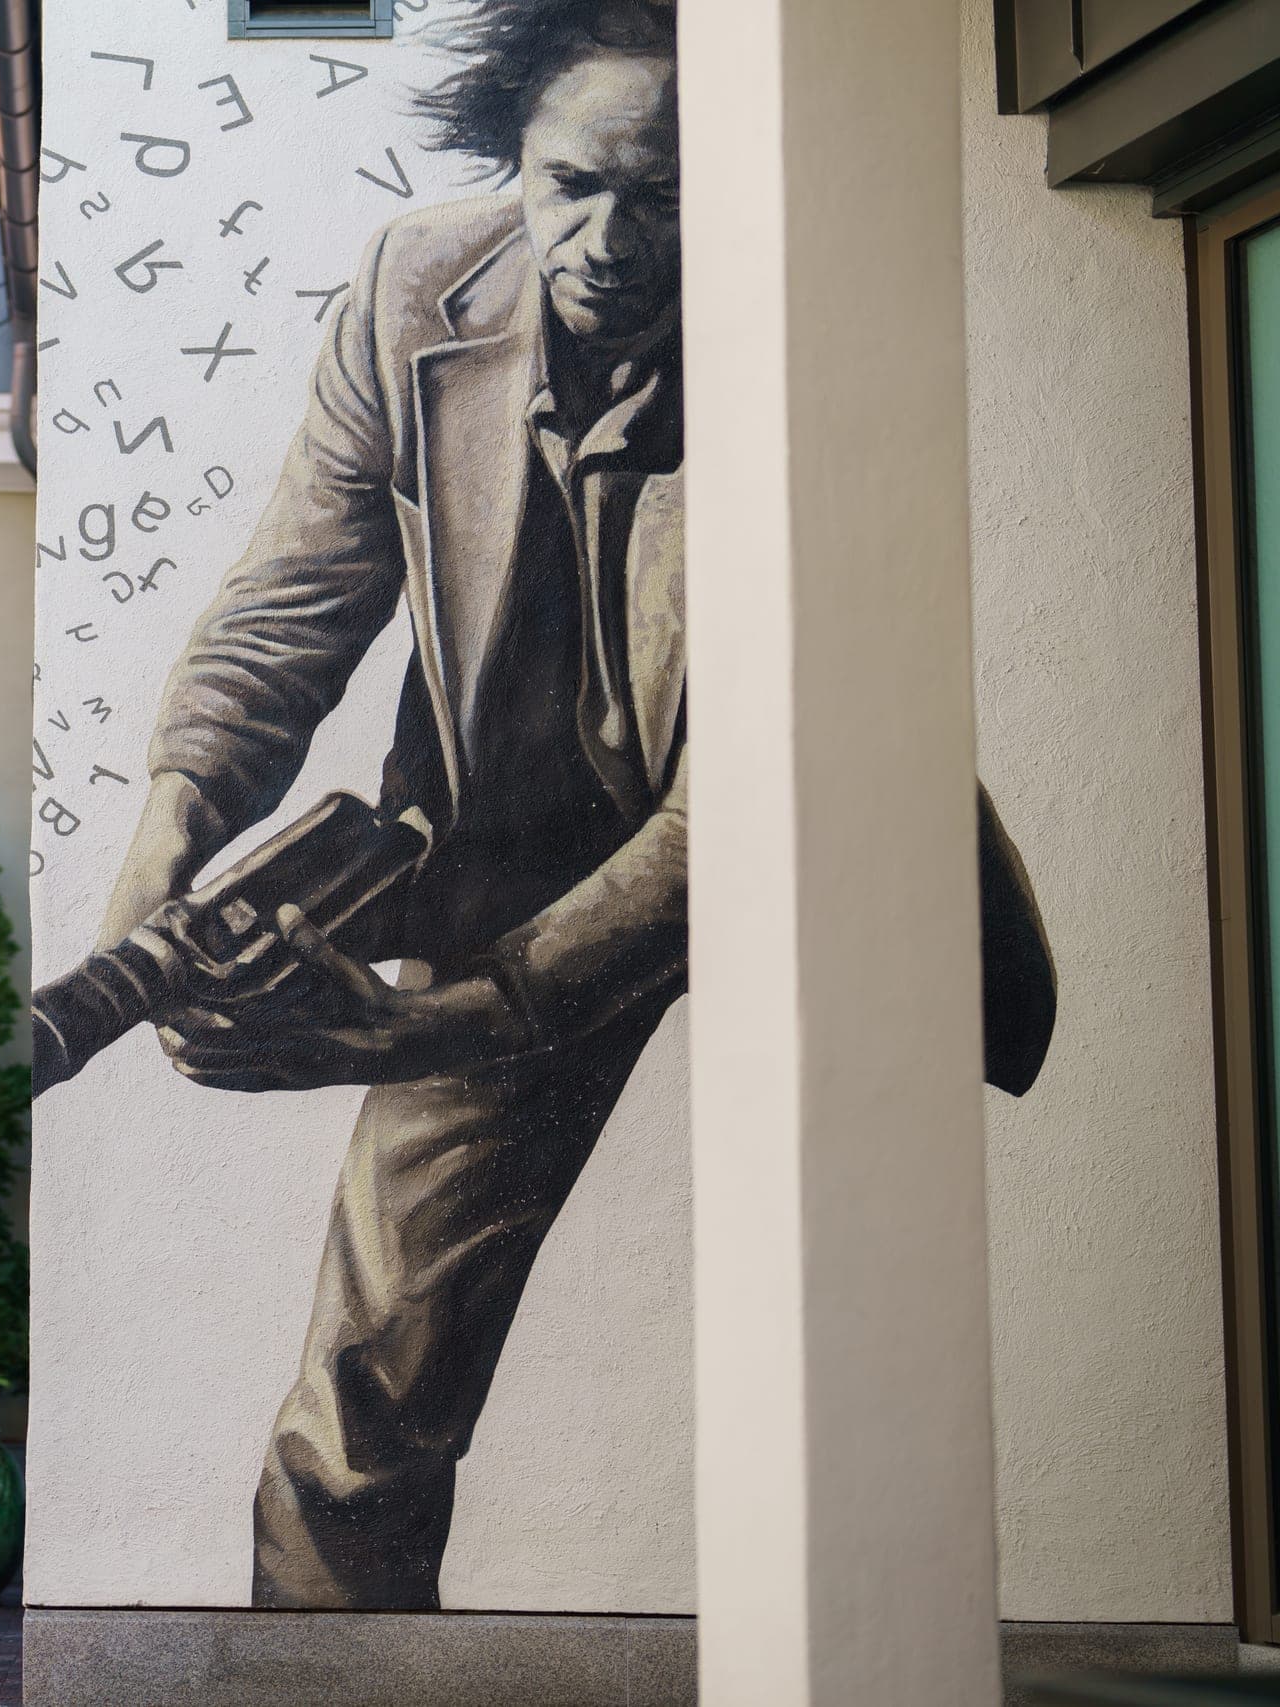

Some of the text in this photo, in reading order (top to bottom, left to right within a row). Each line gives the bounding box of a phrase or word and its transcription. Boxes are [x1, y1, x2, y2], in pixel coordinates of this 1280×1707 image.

[310, 54, 369, 99] A
[203, 465, 234, 500] D
[78, 503, 116, 562] g
[38, 796, 82, 837] B
